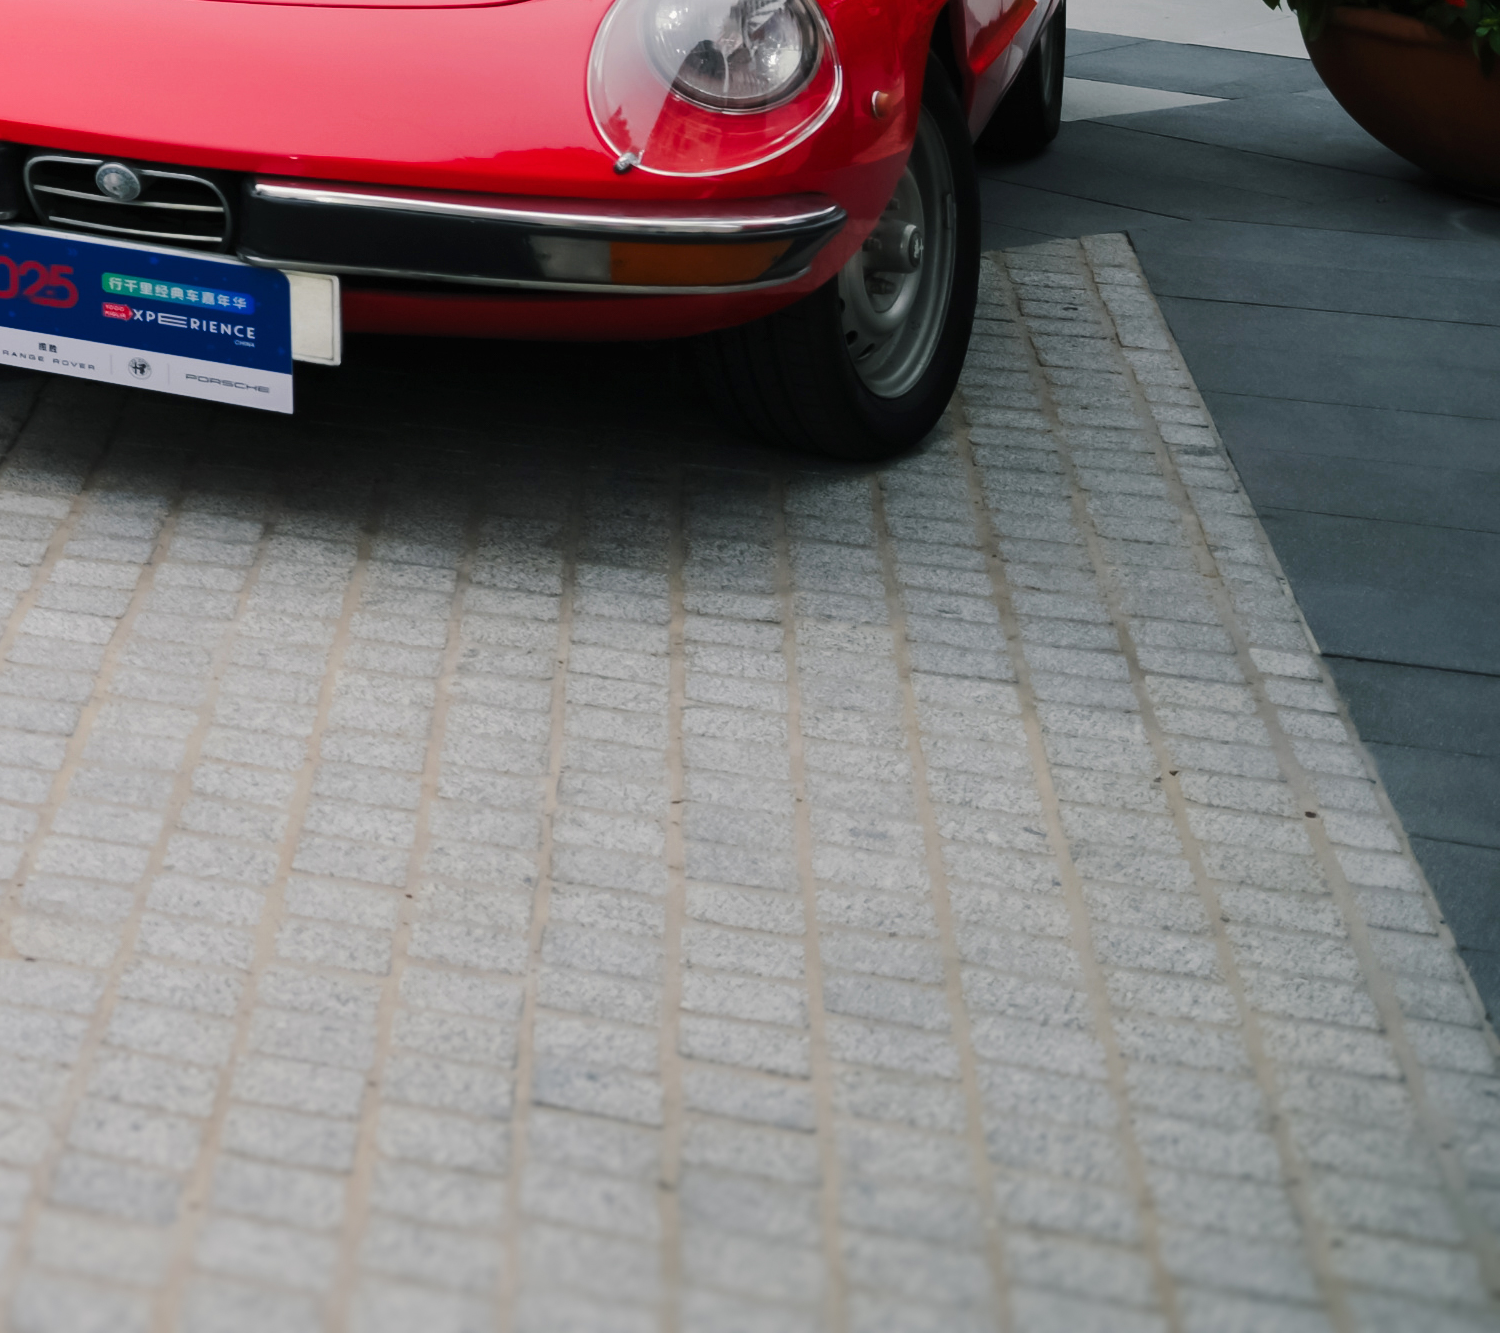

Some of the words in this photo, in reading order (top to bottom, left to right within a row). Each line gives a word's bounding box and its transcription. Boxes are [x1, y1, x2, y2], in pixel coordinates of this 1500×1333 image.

[108, 276, 248, 310] 行千里经典车嘉年华
[233, 339, 256, 348] CHINA
[2, 349, 45, 362] RANGE
[52, 358, 95, 371] ROVER
[185, 373, 271, 394] PORSCHE
